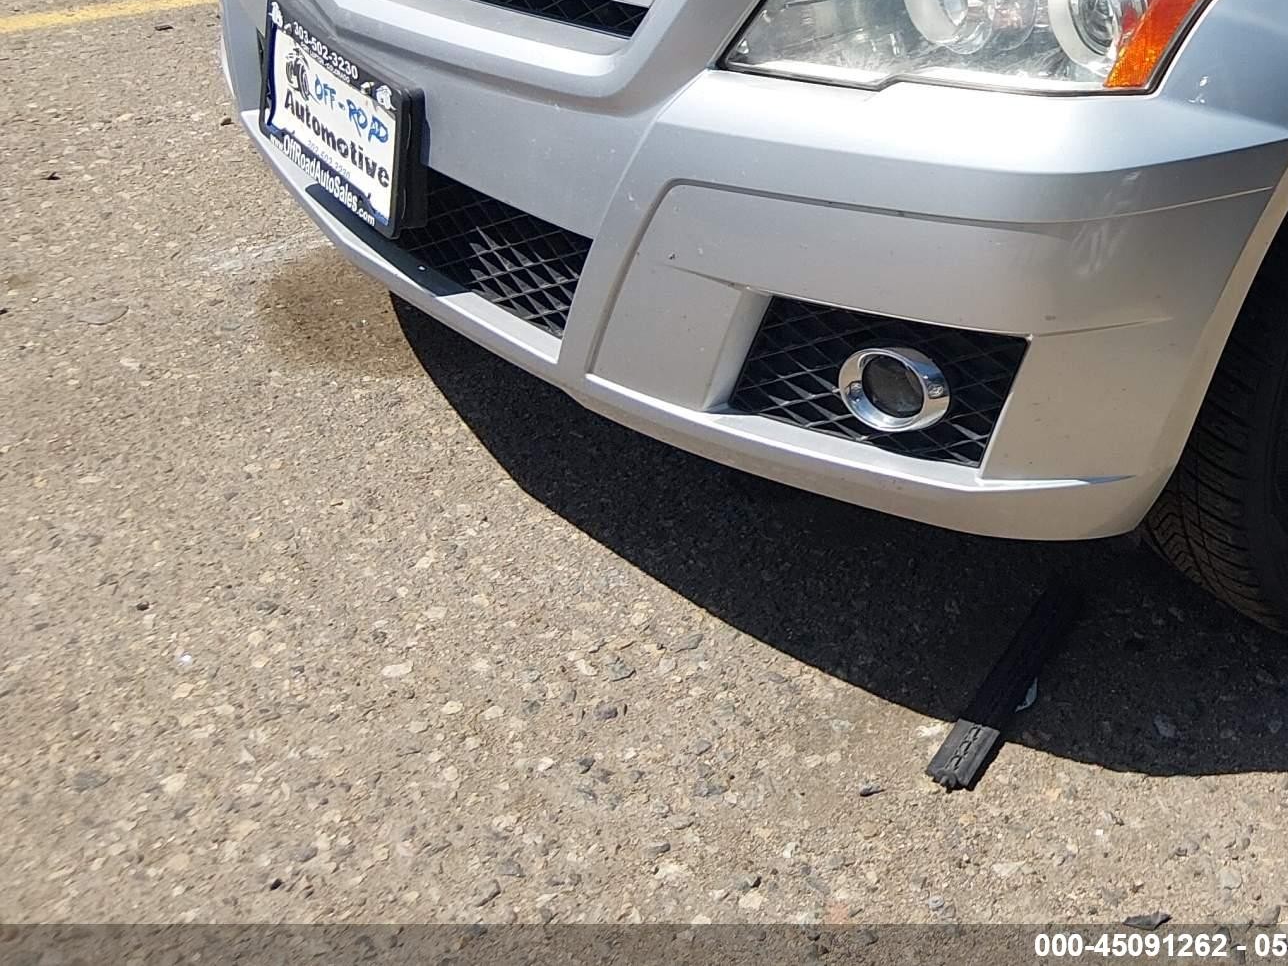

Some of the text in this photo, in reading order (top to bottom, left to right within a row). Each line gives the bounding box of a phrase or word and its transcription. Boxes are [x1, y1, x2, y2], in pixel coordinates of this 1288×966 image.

[293, 21, 359, 80] 303-502-3230
[269, 132, 376, 227] www.OffRoadAutoSales.com
[284, 88, 390, 188] Automotive
